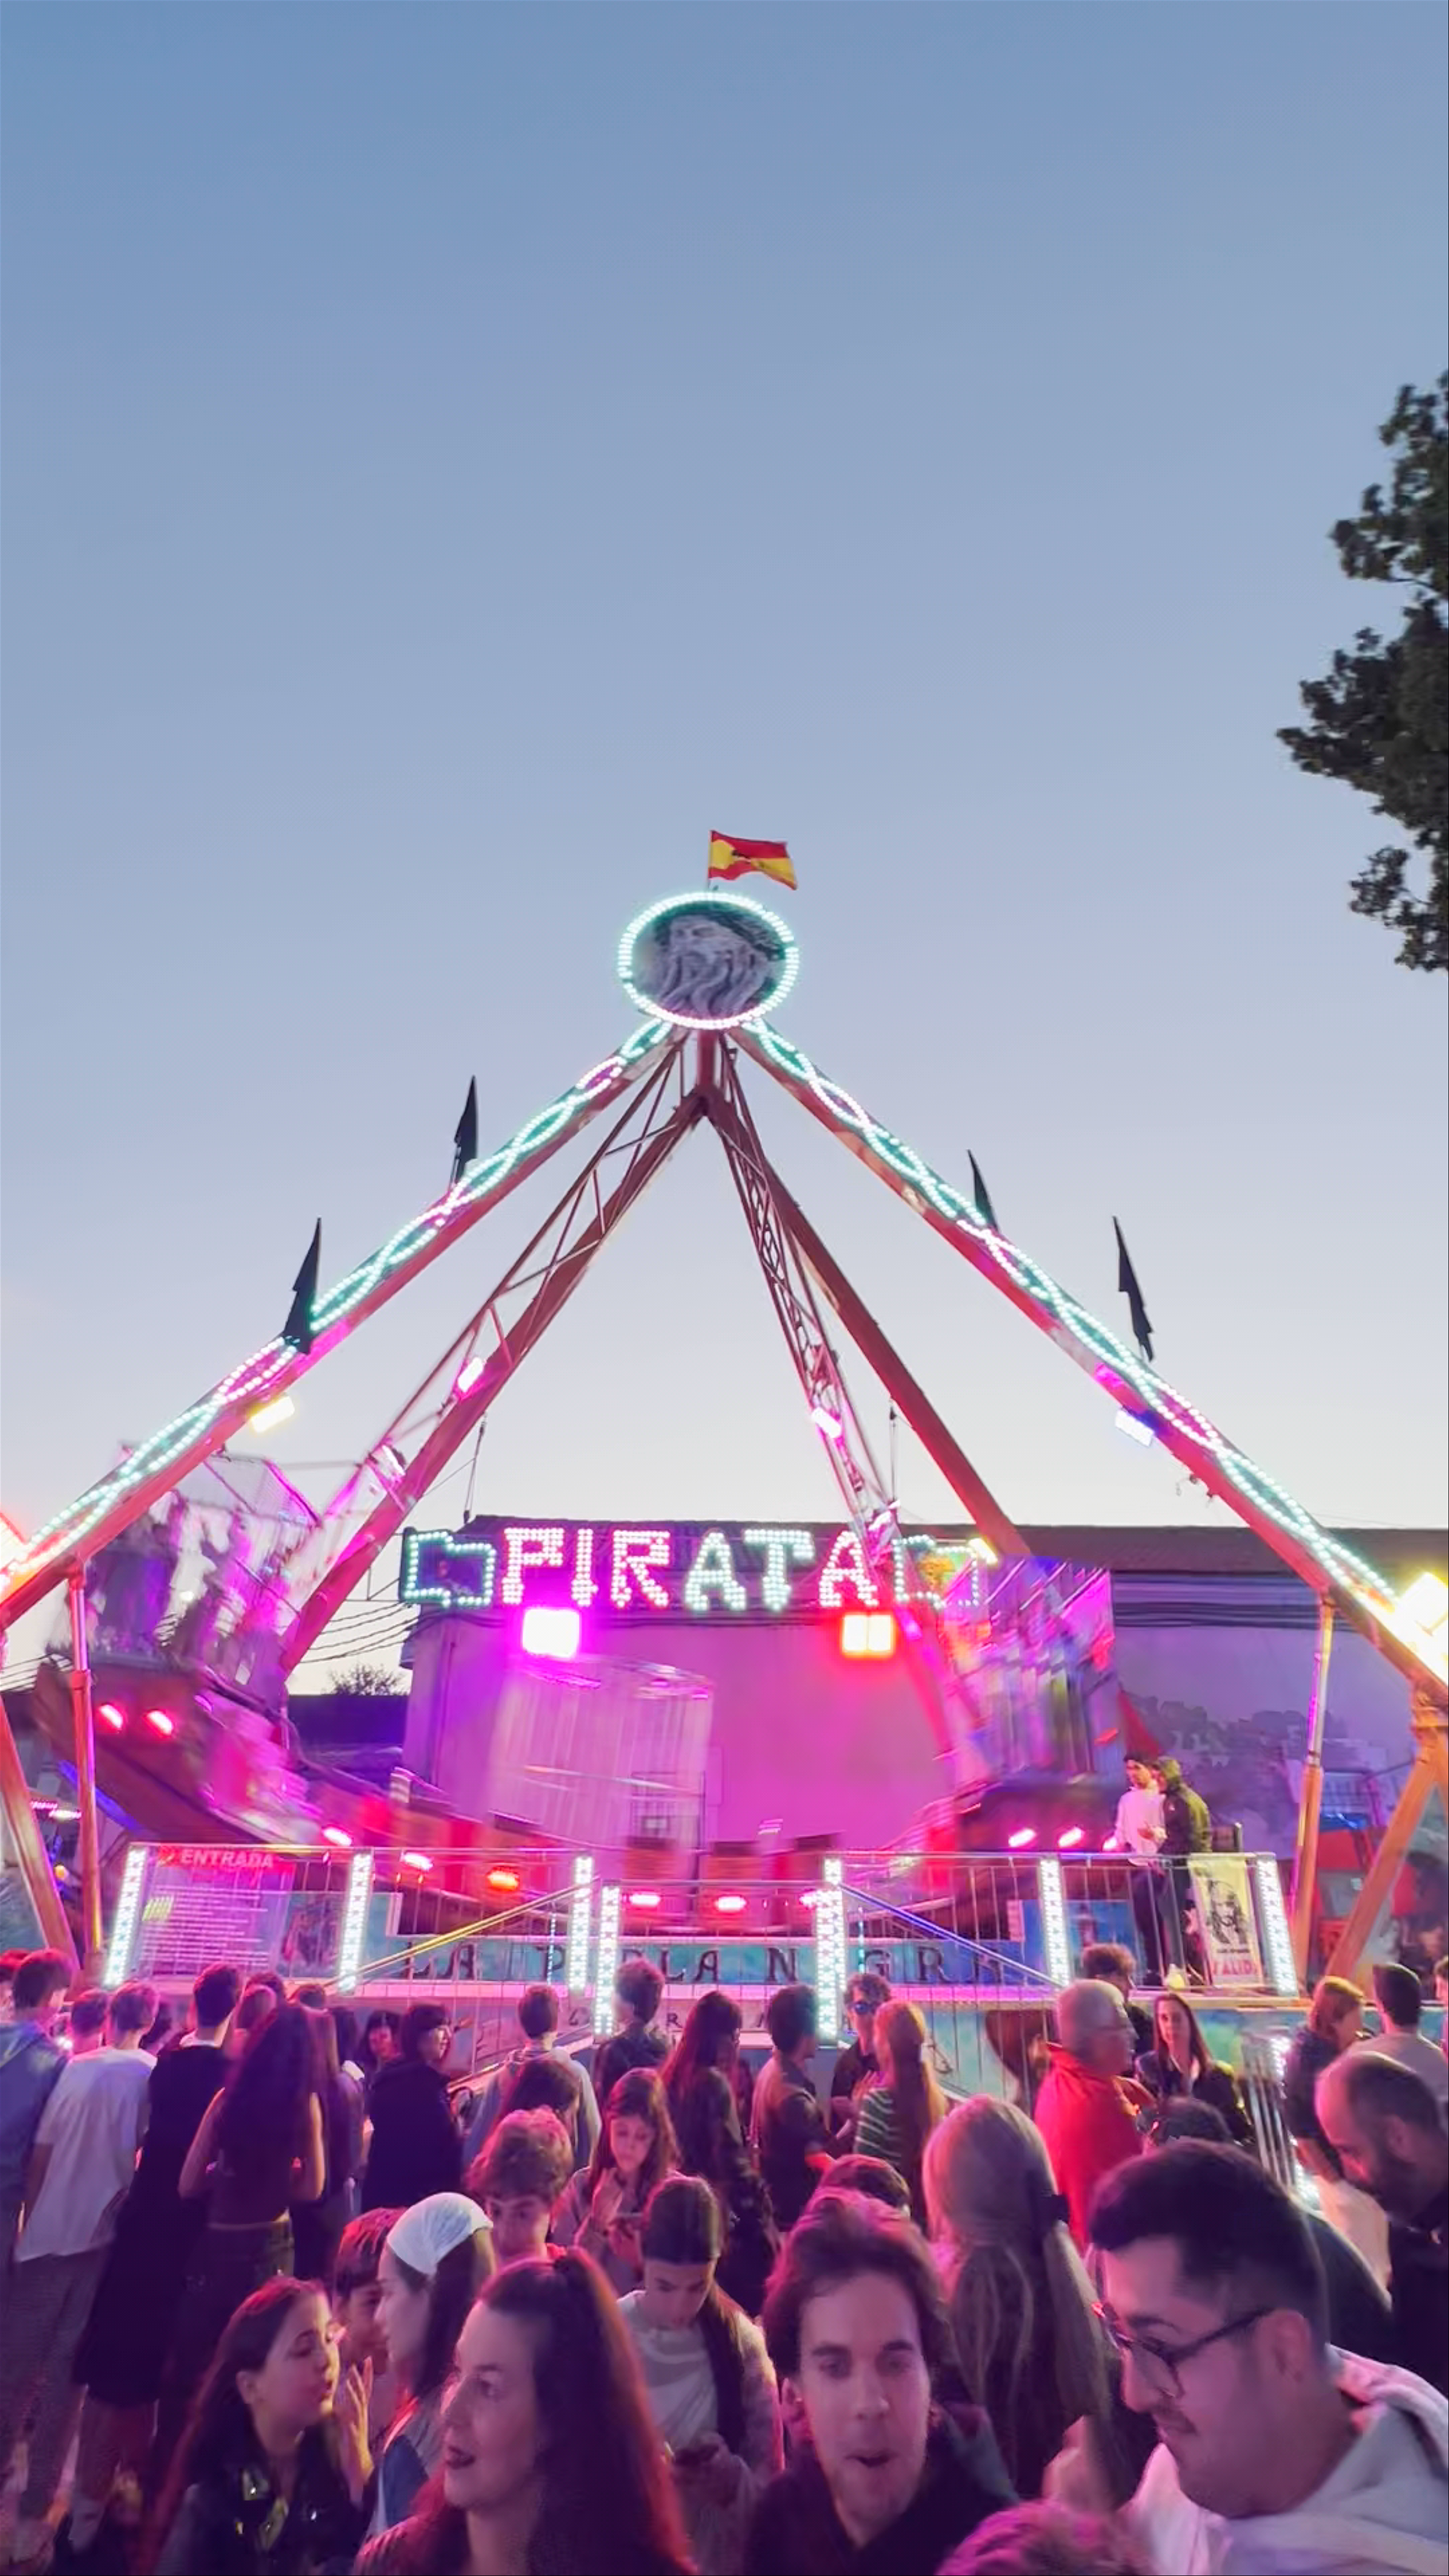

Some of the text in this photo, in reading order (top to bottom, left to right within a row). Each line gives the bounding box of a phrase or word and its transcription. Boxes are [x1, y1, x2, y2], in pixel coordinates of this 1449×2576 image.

[502, 1527, 879, 1611] PIRATA
[179, 1848, 273, 1868] ENTRADA
[534, 1943, 719, 1982] PLA
[764, 1945, 1002, 1983] NGRA
